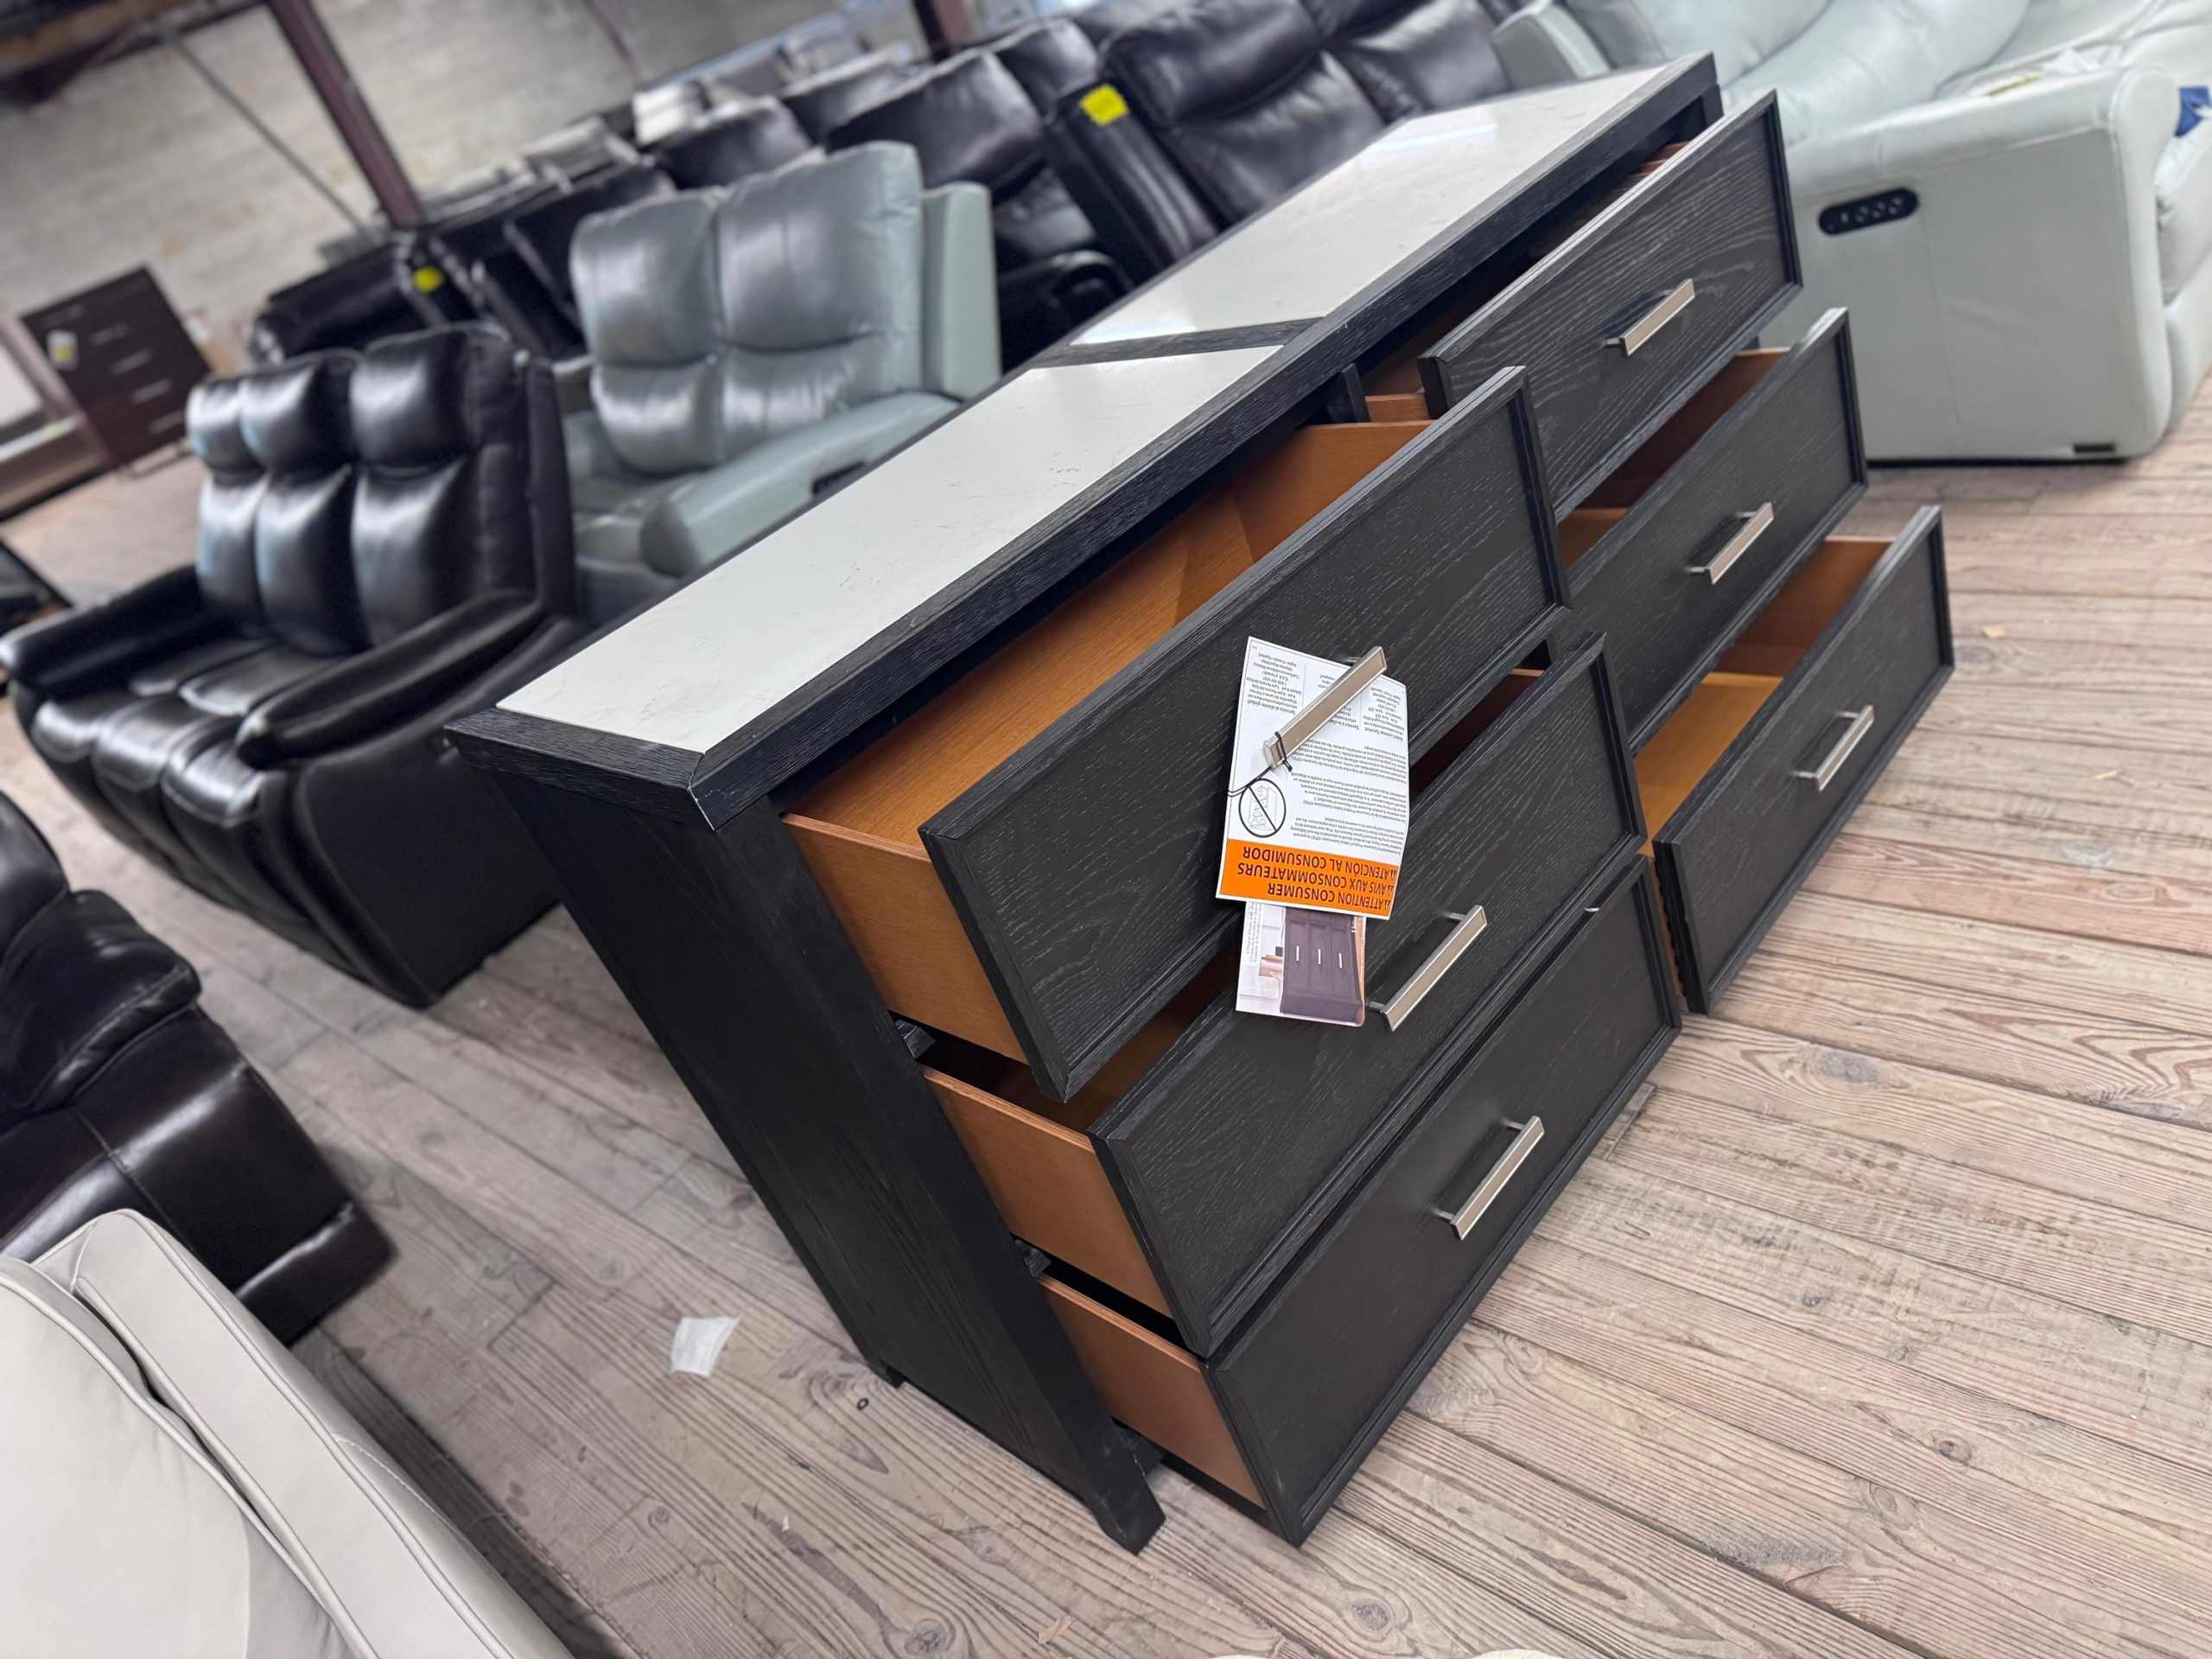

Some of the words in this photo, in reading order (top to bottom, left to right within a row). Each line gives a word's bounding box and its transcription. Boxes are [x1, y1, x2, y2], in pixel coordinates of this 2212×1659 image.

[1243, 845, 1327, 869] CONSUMIDOR
[1329, 858, 1343, 872] AL
[1237, 862, 1347, 889] CONSOMMATEURS
[1344, 861, 1390, 880] ATENCIÓN
[1267, 882, 1336, 903] CONSUMER
[1349, 877, 1369, 893] AUX
[1369, 881, 1387, 895] AVIS
[1338, 891, 1384, 911] ATTENTION
